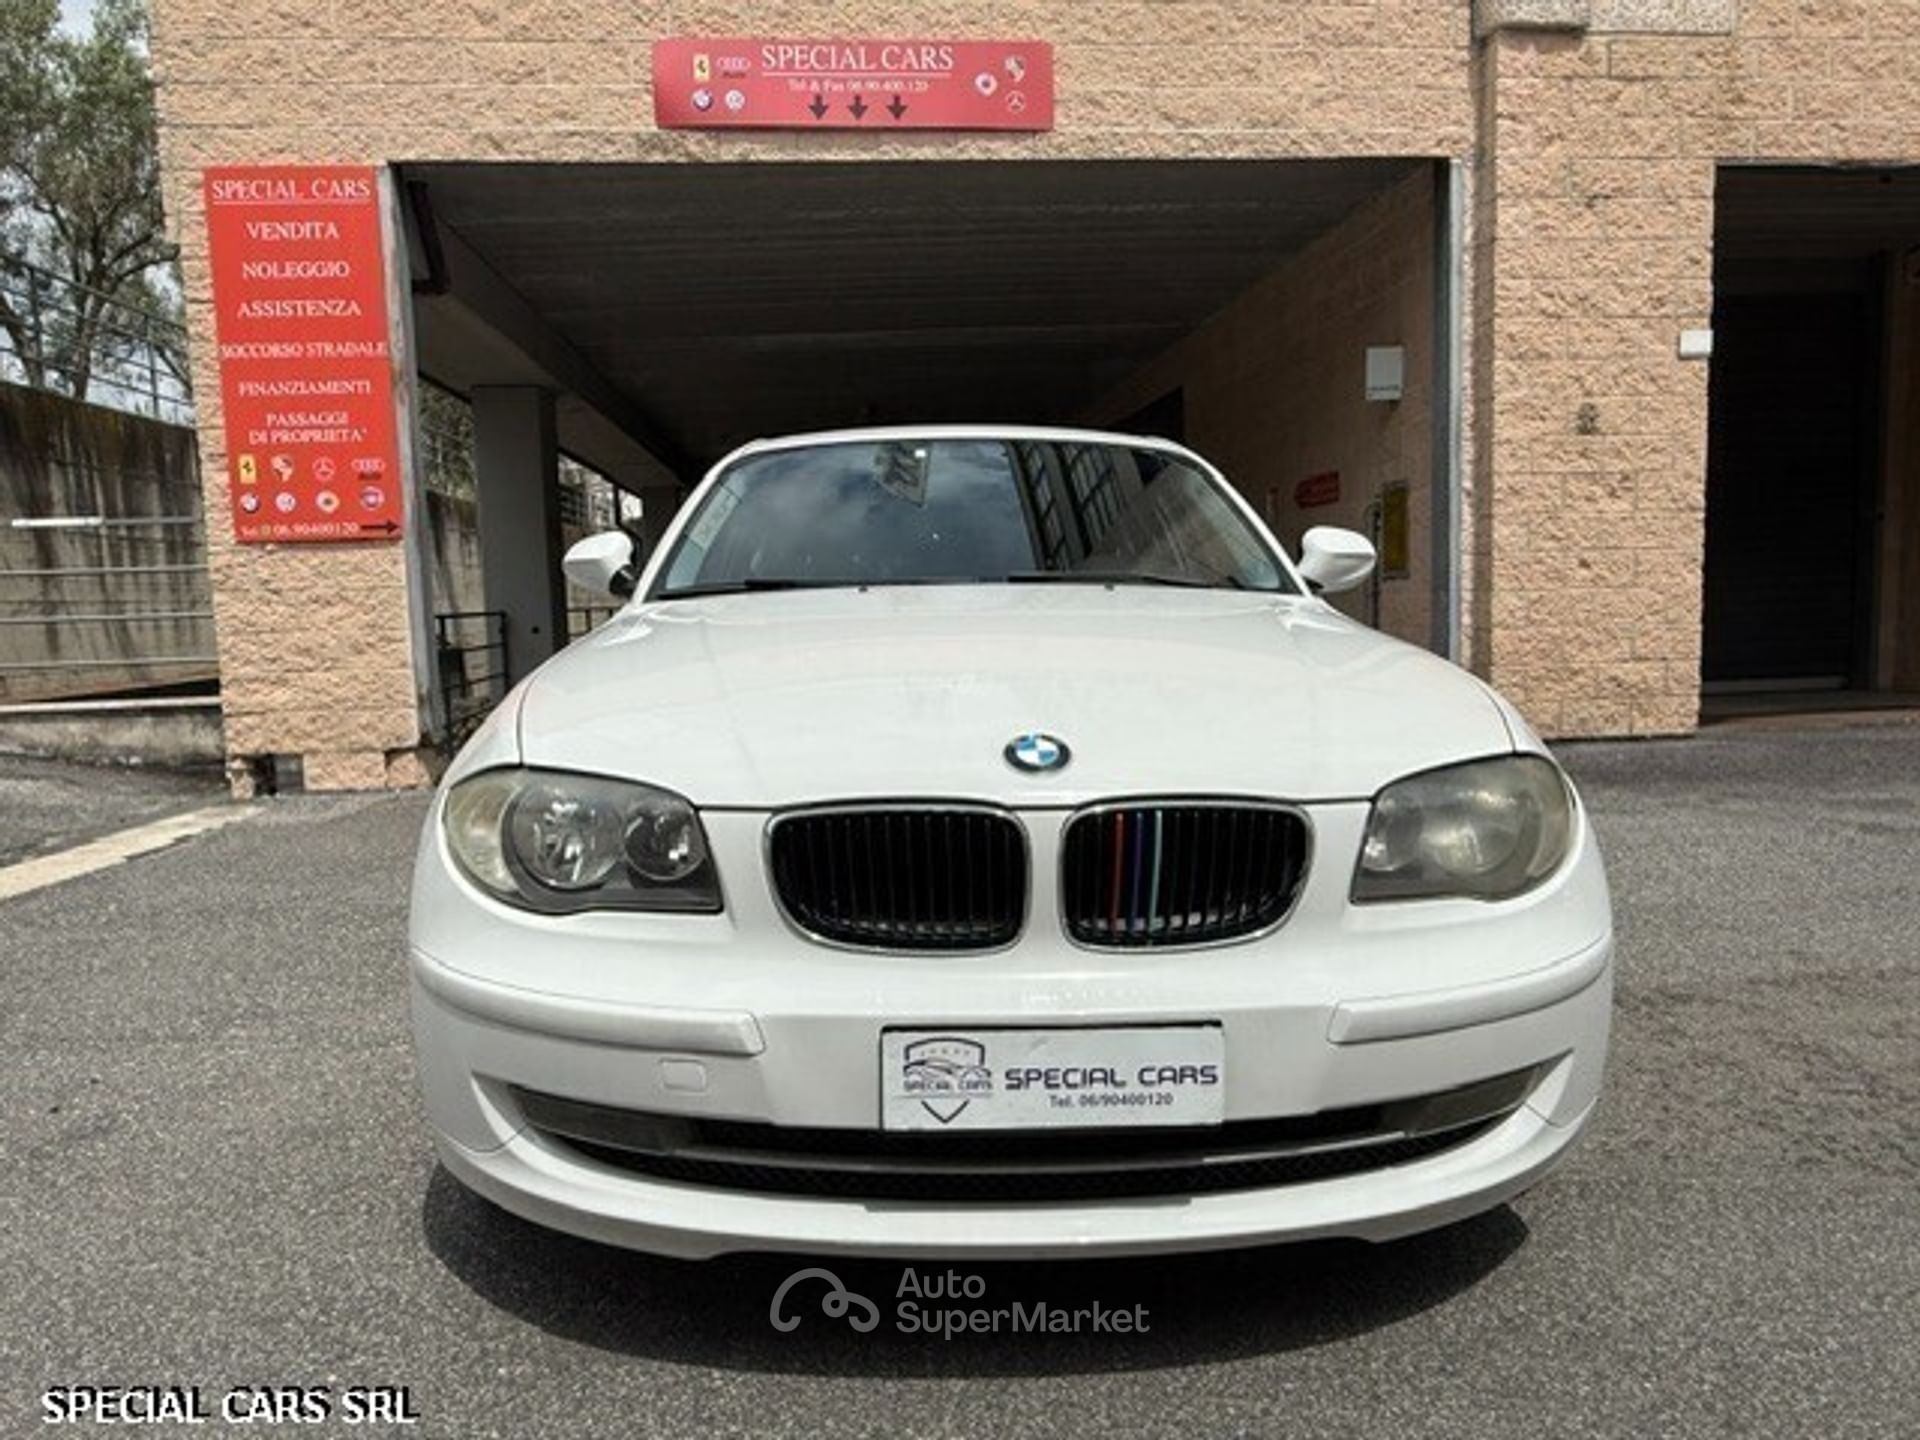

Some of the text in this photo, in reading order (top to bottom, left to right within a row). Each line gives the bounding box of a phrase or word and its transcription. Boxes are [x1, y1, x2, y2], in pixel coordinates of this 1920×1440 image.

[761, 45, 954, 70] SPECIAL CARS
[211, 178, 371, 198] SPECIAL CARS
[246, 221, 340, 240] VENDITA
[242, 261, 350, 279] NOLEGGIO
[237, 299, 361, 318] ASSISTENZA
[305, 341, 388, 358] STRADALE
[238, 380, 371, 396] FINANZIAMENTI
[266, 411, 349, 427] PASSAGGI
[249, 428, 368, 445] DI PROPRIETA'
[1005, 1065, 1219, 1090] SPECIAL CARS
[1050, 1092, 1174, 1108] Tel. 06/90400120
